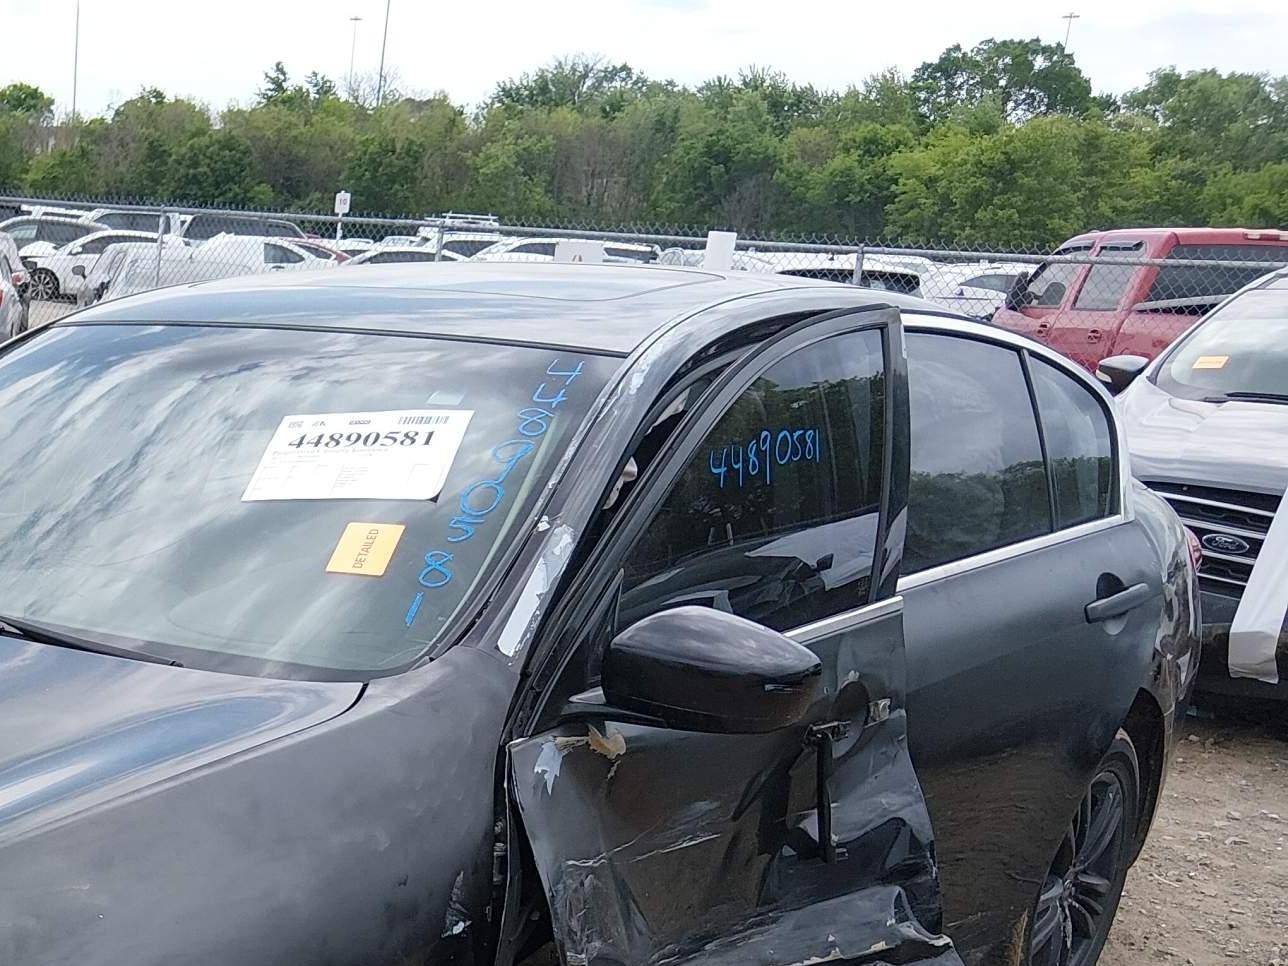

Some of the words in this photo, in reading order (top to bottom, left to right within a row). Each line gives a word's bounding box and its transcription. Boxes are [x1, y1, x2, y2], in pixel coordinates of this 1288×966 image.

[287, 430, 436, 449] 44890581
[710, 428, 820, 489] 44890581
[404, 359, 585, 626] 44890581
[352, 528, 379, 569] DETAILED
[1212, 536, 1239, 550] Ford
